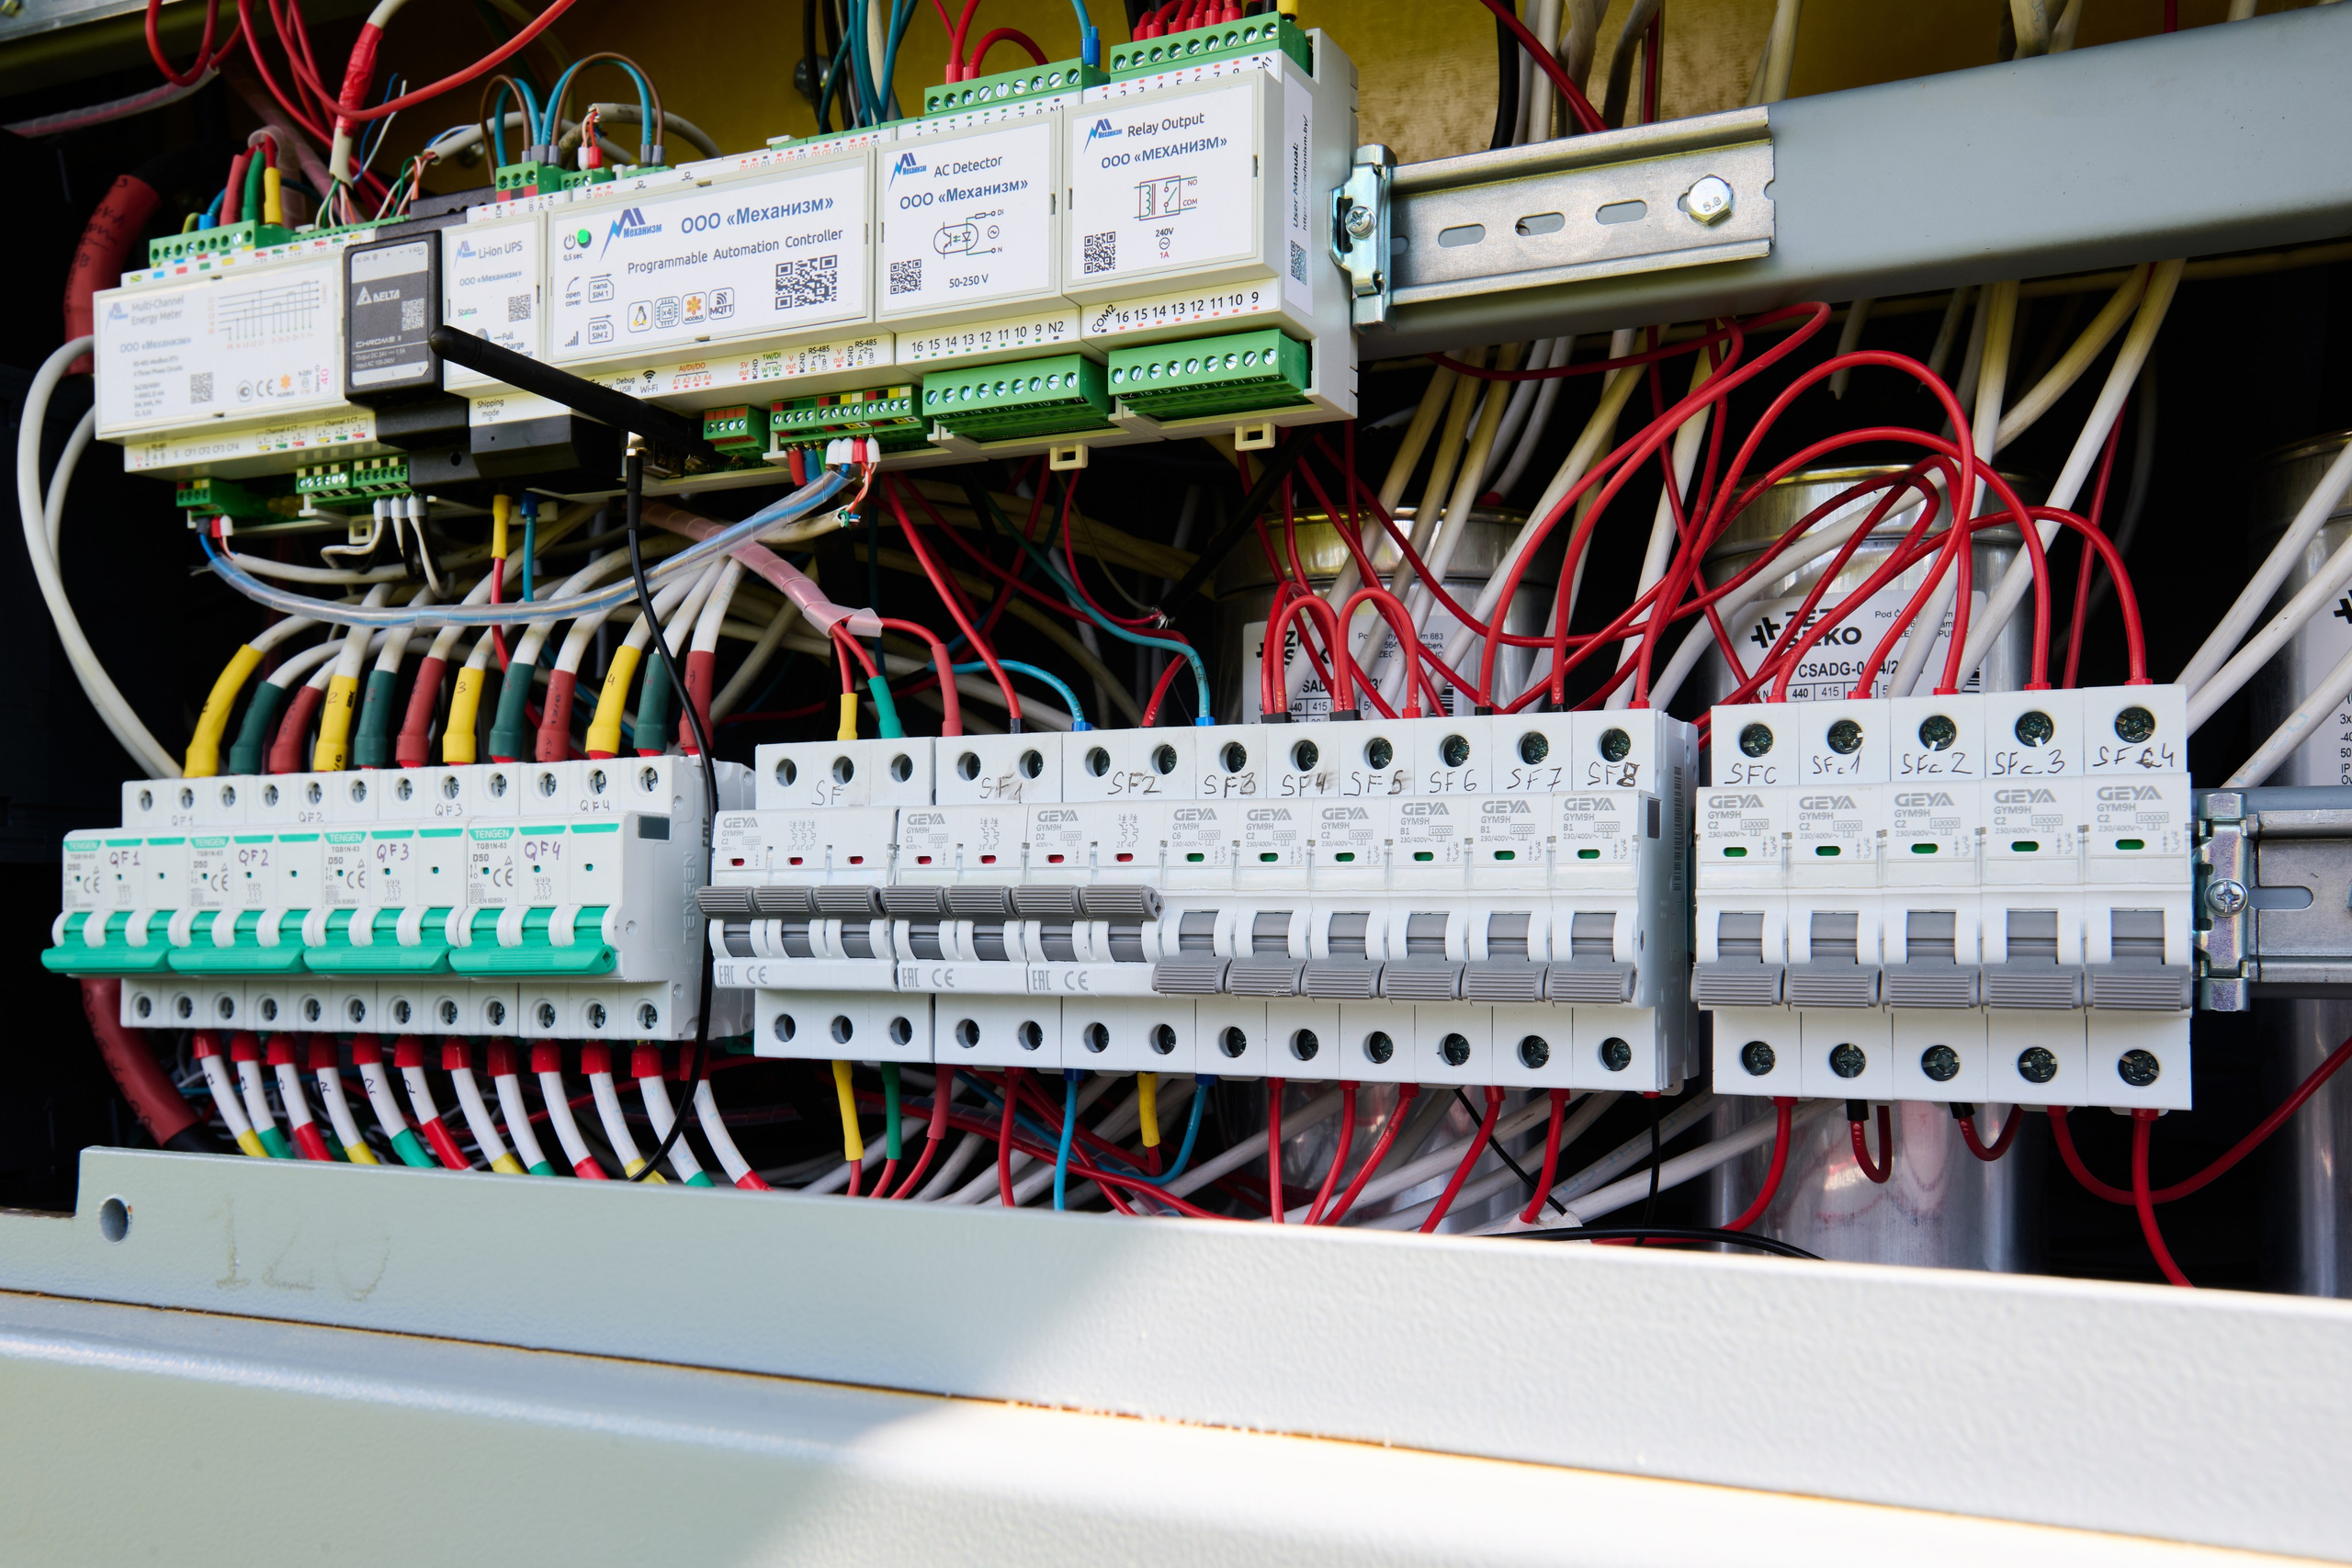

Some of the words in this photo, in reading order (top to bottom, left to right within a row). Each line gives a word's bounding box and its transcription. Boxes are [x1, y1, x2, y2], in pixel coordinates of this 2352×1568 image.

[1128, 122, 1159, 137] Relay
[1161, 113, 1204, 130] Output
[1098, 129, 1122, 139] Механизм
[1102, 153, 1130, 168] ООО
[1134, 137, 1227, 163] «МЕХАНИЗМ»
[902, 165, 926, 175] Механизм
[934, 164, 949, 177] AC
[953, 156, 1002, 174] Detector
[900, 192, 933, 209] ООО
[938, 180, 1028, 203] «Механизм»
[682, 213, 720, 233] ООО
[727, 197, 833, 225] «Механизм»
[623, 224, 662, 238] Механизм
[1156, 227, 1174, 237] 240V
[479, 247, 503, 259] Li-ion
[504, 243, 522, 254] UPS
[628, 251, 707, 274] Programmable
[713, 241, 779, 260] Automation
[786, 230, 842, 248] Controller
[949, 275, 980, 288] 50-250
[982, 274, 989, 283] V
[373, 289, 400, 302] DELTA
[131, 295, 185, 312] Multi-Channel
[710, 304, 732, 315] MQTT
[131, 311, 158, 326] Energy
[160, 310, 182, 321] Meter
[458, 307, 477, 316] Status
[1092, 304, 1116, 333] COM2
[1115, 310, 1129, 323] 16
[1134, 309, 1148, 321] 15
[1152, 306, 1166, 318] 14
[1171, 302, 1185, 315] 13
[1190, 300, 1204, 312] 12
[1210, 297, 1224, 309] 11
[1228, 294, 1243, 306] 10
[1251, 292, 1259, 303] 9
[502, 332, 514, 341] Full
[855, 339, 876, 347] RS-485
[911, 342, 923, 353] 16
[929, 339, 940, 350] 15
[945, 336, 957, 347] 14
[963, 334, 974, 345] 13
[979, 332, 991, 343] 12
[998, 329, 1009, 340] 11
[1014, 327, 1027, 338] 10
[1035, 324, 1042, 335] 9
[1048, 321, 1064, 333] N2
[808, 345, 830, 354] RS-485
[679, 362, 706, 372] AI/DI/DO
[616, 377, 635, 386] Debug
[640, 385, 658, 393] Wi-Fi
[478, 399, 504, 409] Shipping
[482, 409, 500, 418] mode
[606, 673, 615, 686] 4
[458, 681, 467, 694] 3
[1792, 688, 1809, 698] 440
[1821, 686, 1839, 697] 415
[327, 692, 337, 705] 2
[1313, 701, 1328, 711] 415
[1507, 767, 1562, 792] SF7
[1588, 761, 1640, 787] SF8
[1107, 771, 1162, 795] SF2
[1204, 772, 1257, 798] SF3
[1281, 773, 1328, 796] SF4
[1343, 770, 1404, 795] SF5
[1430, 769, 1476, 794] SF6
[811, 780, 844, 806] SF
[1994, 788, 2057, 804] GEYA
[2097, 785, 2163, 800] GEYA
[580, 799, 610, 812] QF4
[1564, 797, 1615, 811] GEYA
[1708, 795, 1764, 809] GEYA
[1799, 795, 1857, 810] GEYA
[1894, 792, 1954, 807] GEYA
[435, 804, 463, 818] QF3
[1321, 807, 1369, 820] GEYA
[1401, 802, 1450, 815] GEYA
[1481, 800, 1532, 814] GEYA
[2098, 803, 2136, 812] GYM9H
[299, 811, 324, 823] QF2
[907, 813, 945, 825] GEYA
[1037, 809, 1079, 822] GEYA
[1173, 808, 1217, 821] GEYA
[1247, 808, 1293, 820] GEYA
[1564, 813, 1595, 821] GYM9H
[1708, 811, 1741, 819] GYM9H
[723, 817, 758, 828] GEYA
[329, 832, 362, 842] TENGEN
[474, 829, 510, 839] TENGEN
[68, 841, 97, 850] TENGEN
[194, 838, 225, 847] TENGEN
[377, 842, 410, 862] QF3
[473, 853, 489, 862] D50
[524, 840, 560, 862] QF4
[109, 850, 141, 868] QF1
[238, 849, 269, 867] QF2
[328, 856, 344, 864] D50
